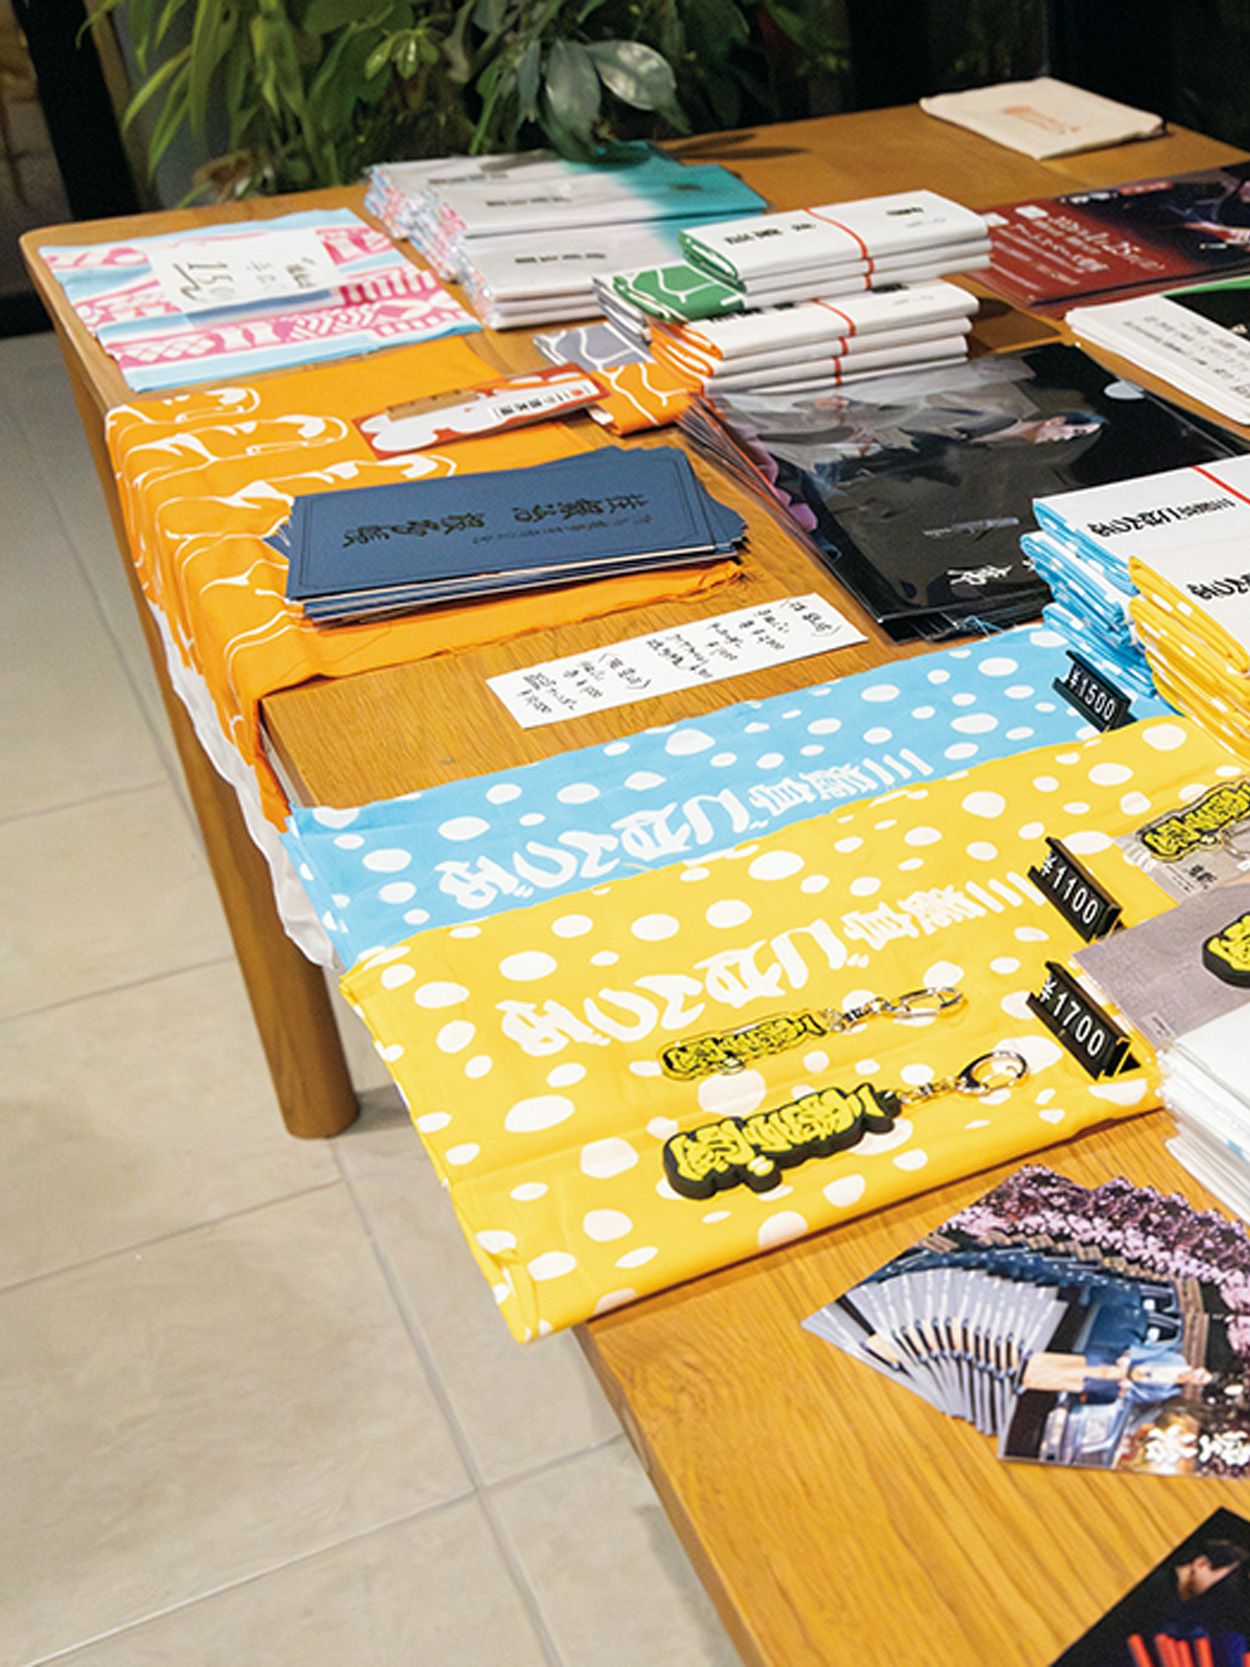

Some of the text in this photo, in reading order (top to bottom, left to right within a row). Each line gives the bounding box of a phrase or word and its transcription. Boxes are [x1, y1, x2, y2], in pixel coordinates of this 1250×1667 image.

[1069, 671, 1115, 722] ¥1500
[435, 747, 935, 912] 三遊亭ごはんつぶ
[1041, 851, 1100, 926] ¥1100
[496, 870, 1048, 1057] 三遊亭ごはんつぶ
[1038, 979, 1106, 1058] ¥1700
